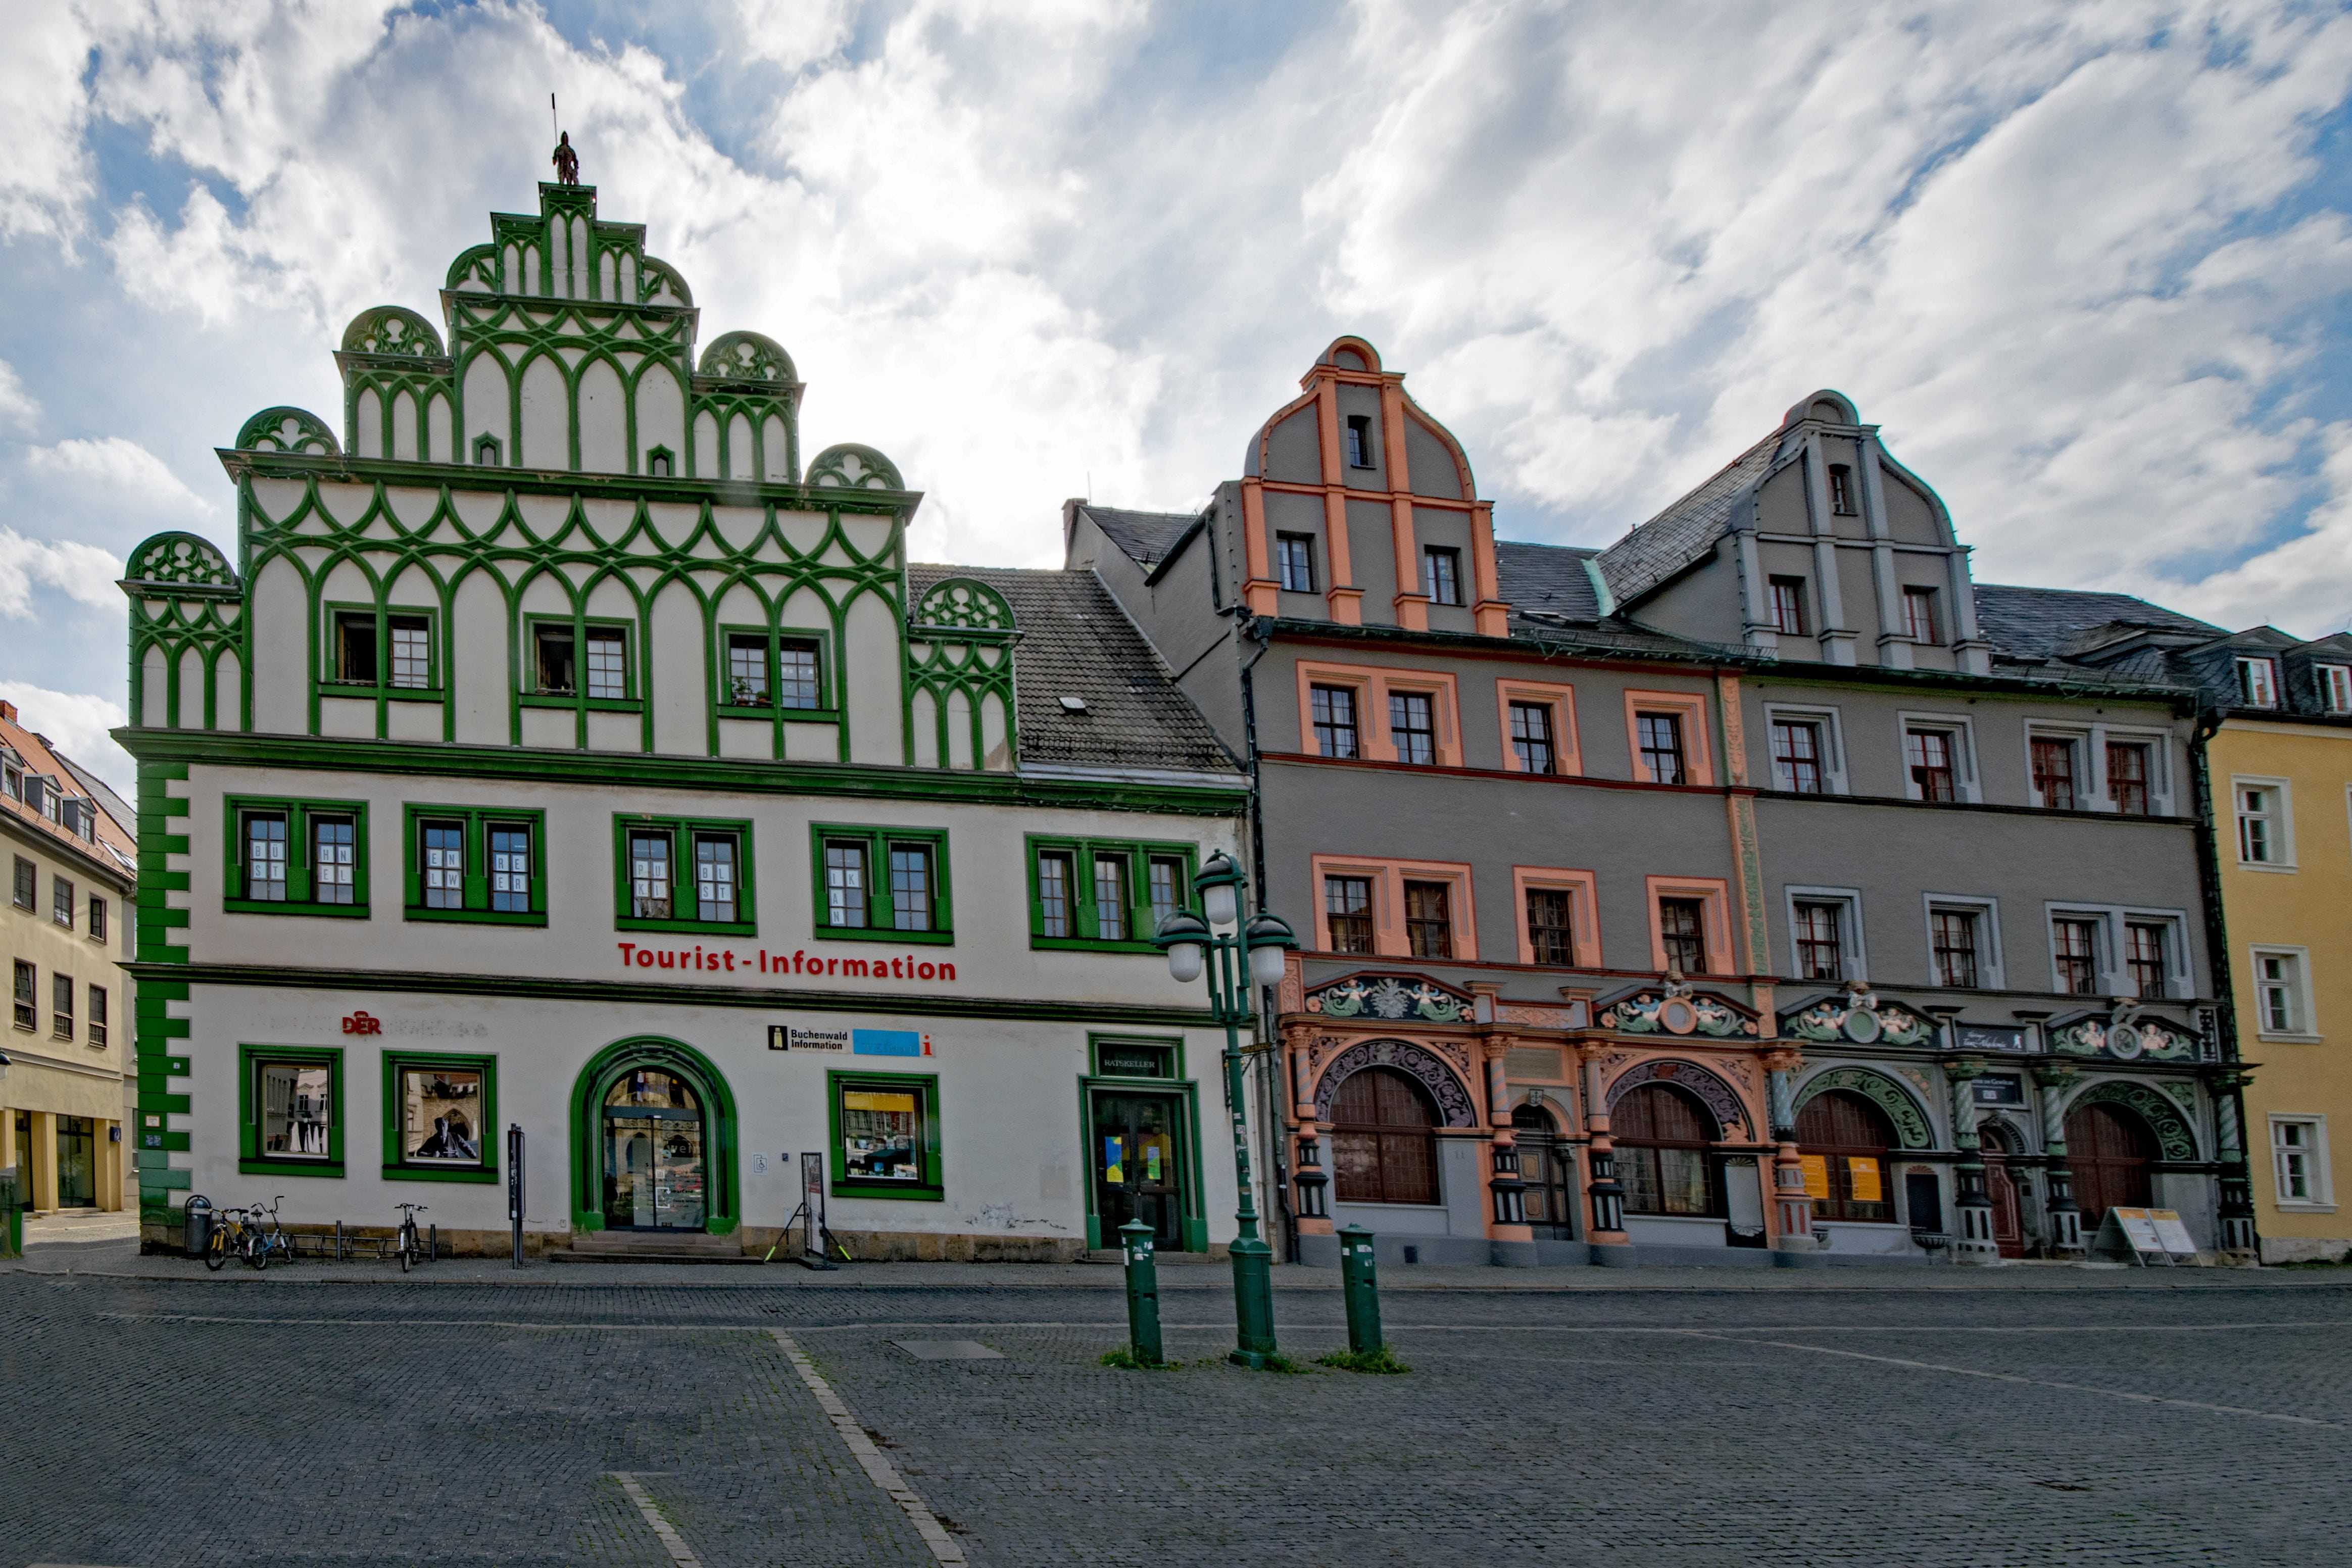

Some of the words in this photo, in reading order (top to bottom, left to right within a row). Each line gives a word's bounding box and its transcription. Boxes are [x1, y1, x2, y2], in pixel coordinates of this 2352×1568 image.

[342, 1015, 382, 1035] DER
[791, 1029, 848, 1041] Buchenwald
[791, 1039, 843, 1050] Information
[1104, 1059, 1156, 1068] RATSKELLER
